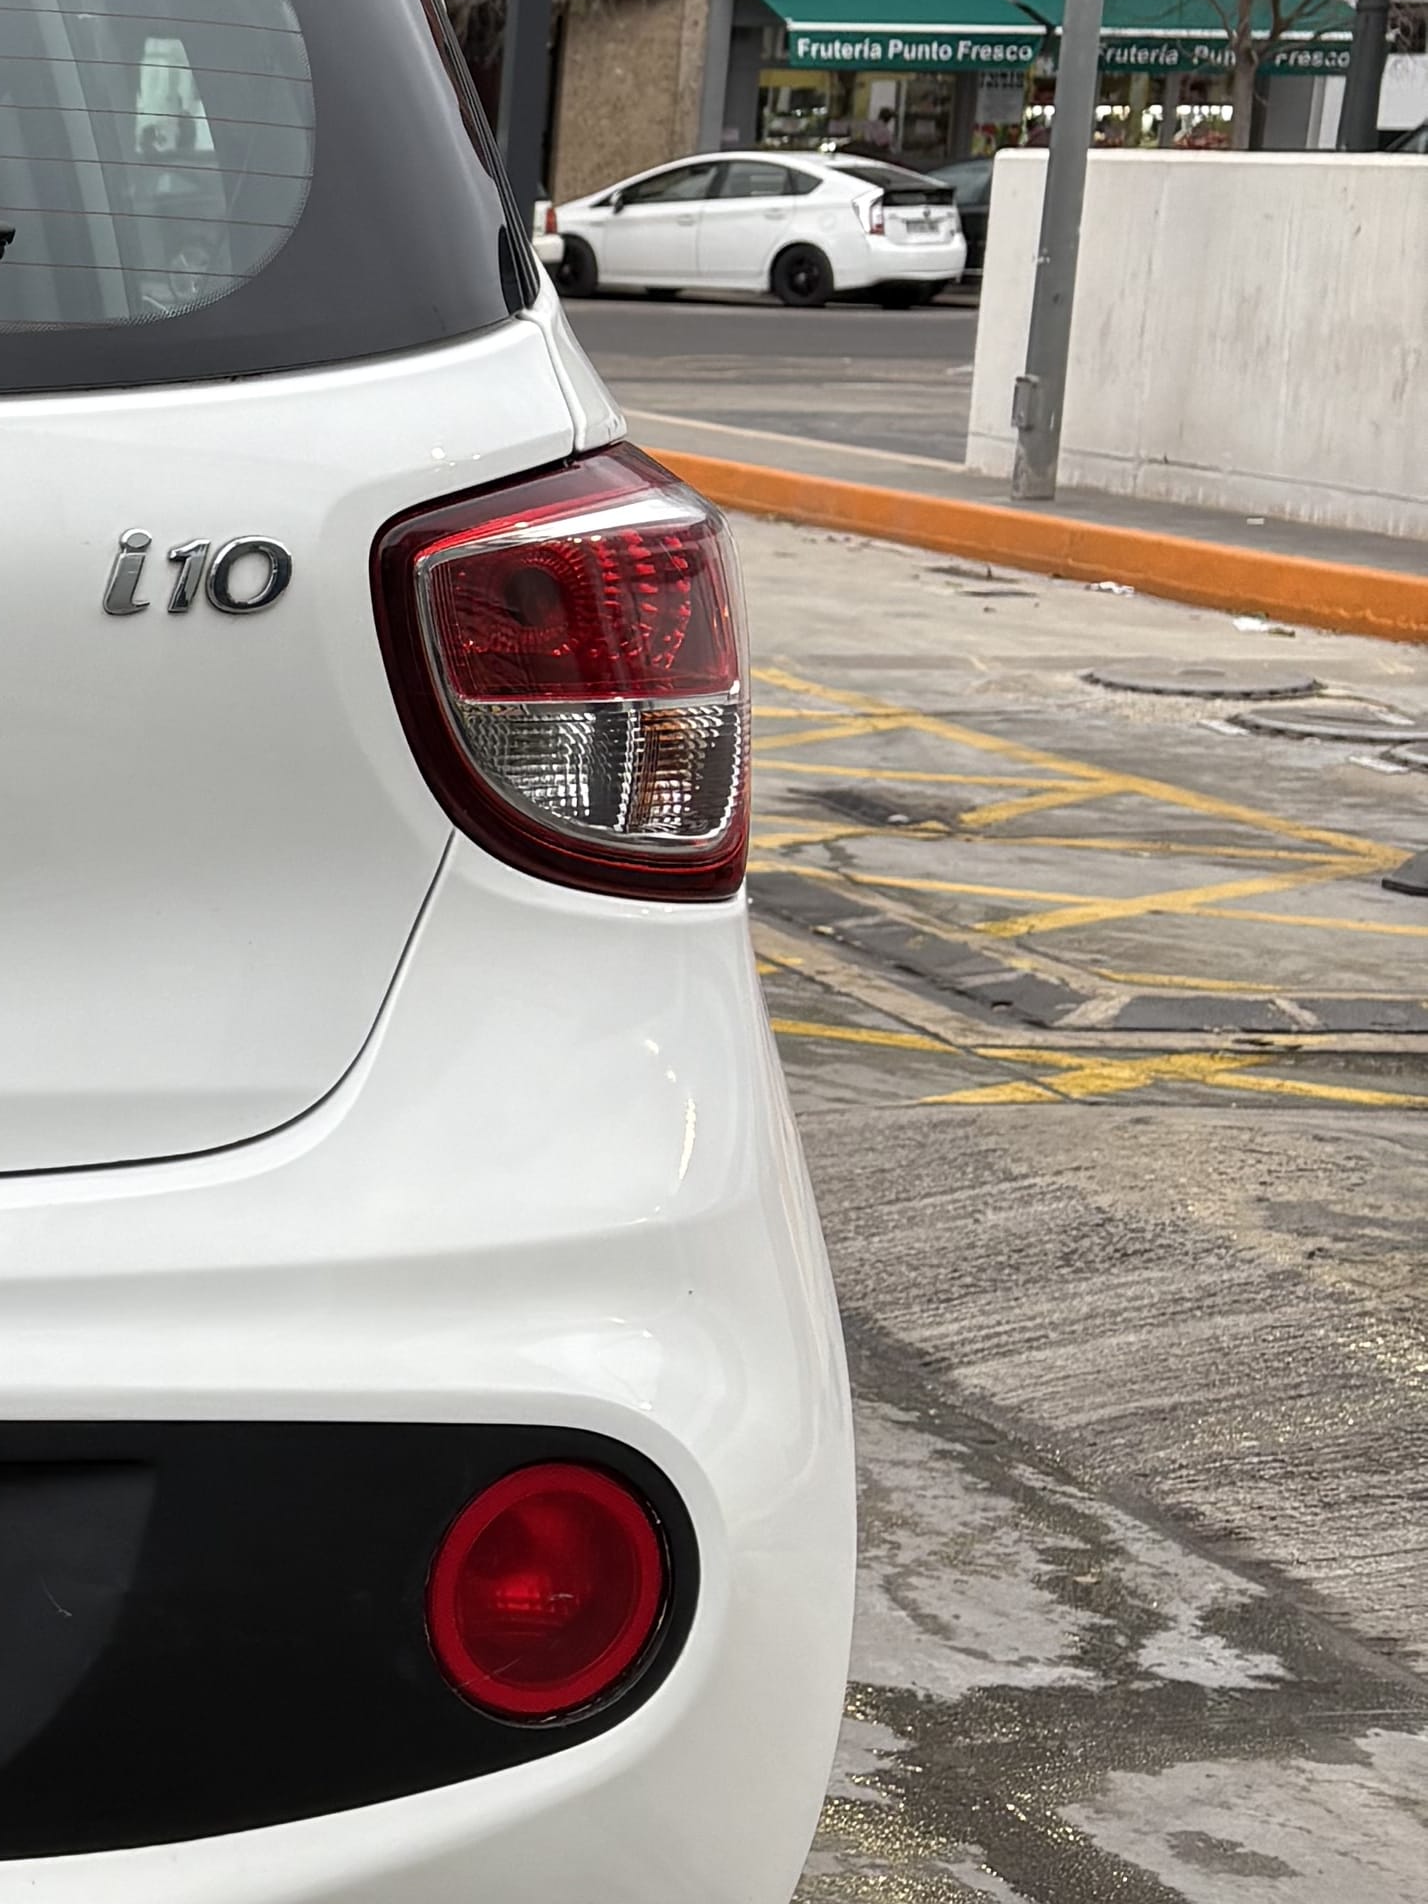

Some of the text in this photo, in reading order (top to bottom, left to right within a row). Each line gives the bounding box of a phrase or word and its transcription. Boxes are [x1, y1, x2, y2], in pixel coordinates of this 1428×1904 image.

[888, 39, 953, 62] Punto
[957, 40, 1033, 62] Fresco
[1192, 45, 1237, 66] Pun
[102, 527, 293, 616] i10
